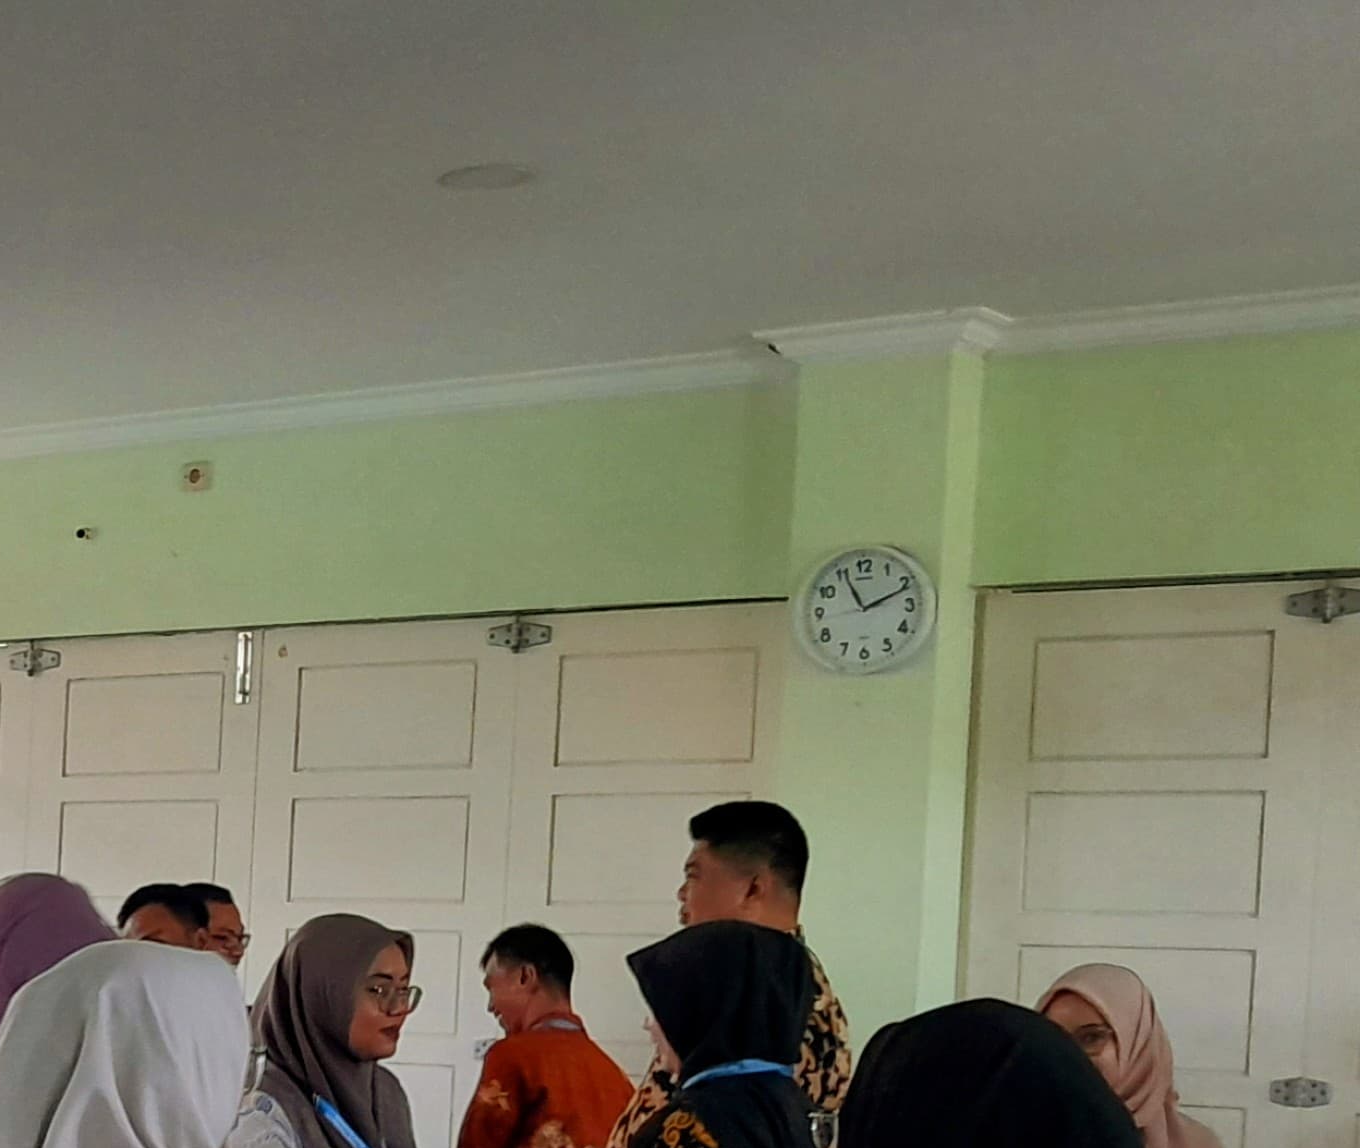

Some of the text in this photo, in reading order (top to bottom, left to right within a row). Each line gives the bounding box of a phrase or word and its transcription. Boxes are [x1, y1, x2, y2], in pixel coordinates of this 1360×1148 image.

[856, 559, 872, 573] 12
[884, 563, 890, 576] 1
[836, 568, 849, 581] 11
[900, 576, 910, 589] 2
[820, 585, 835, 599] 10
[904, 598, 915, 612] 3
[815, 608, 824, 621] 9
[897, 619, 908, 634] 4
[821, 627, 831, 642] 8
[840, 642, 848, 656] 7
[882, 638, 892, 652] 5
[859, 646, 870, 660] 6
